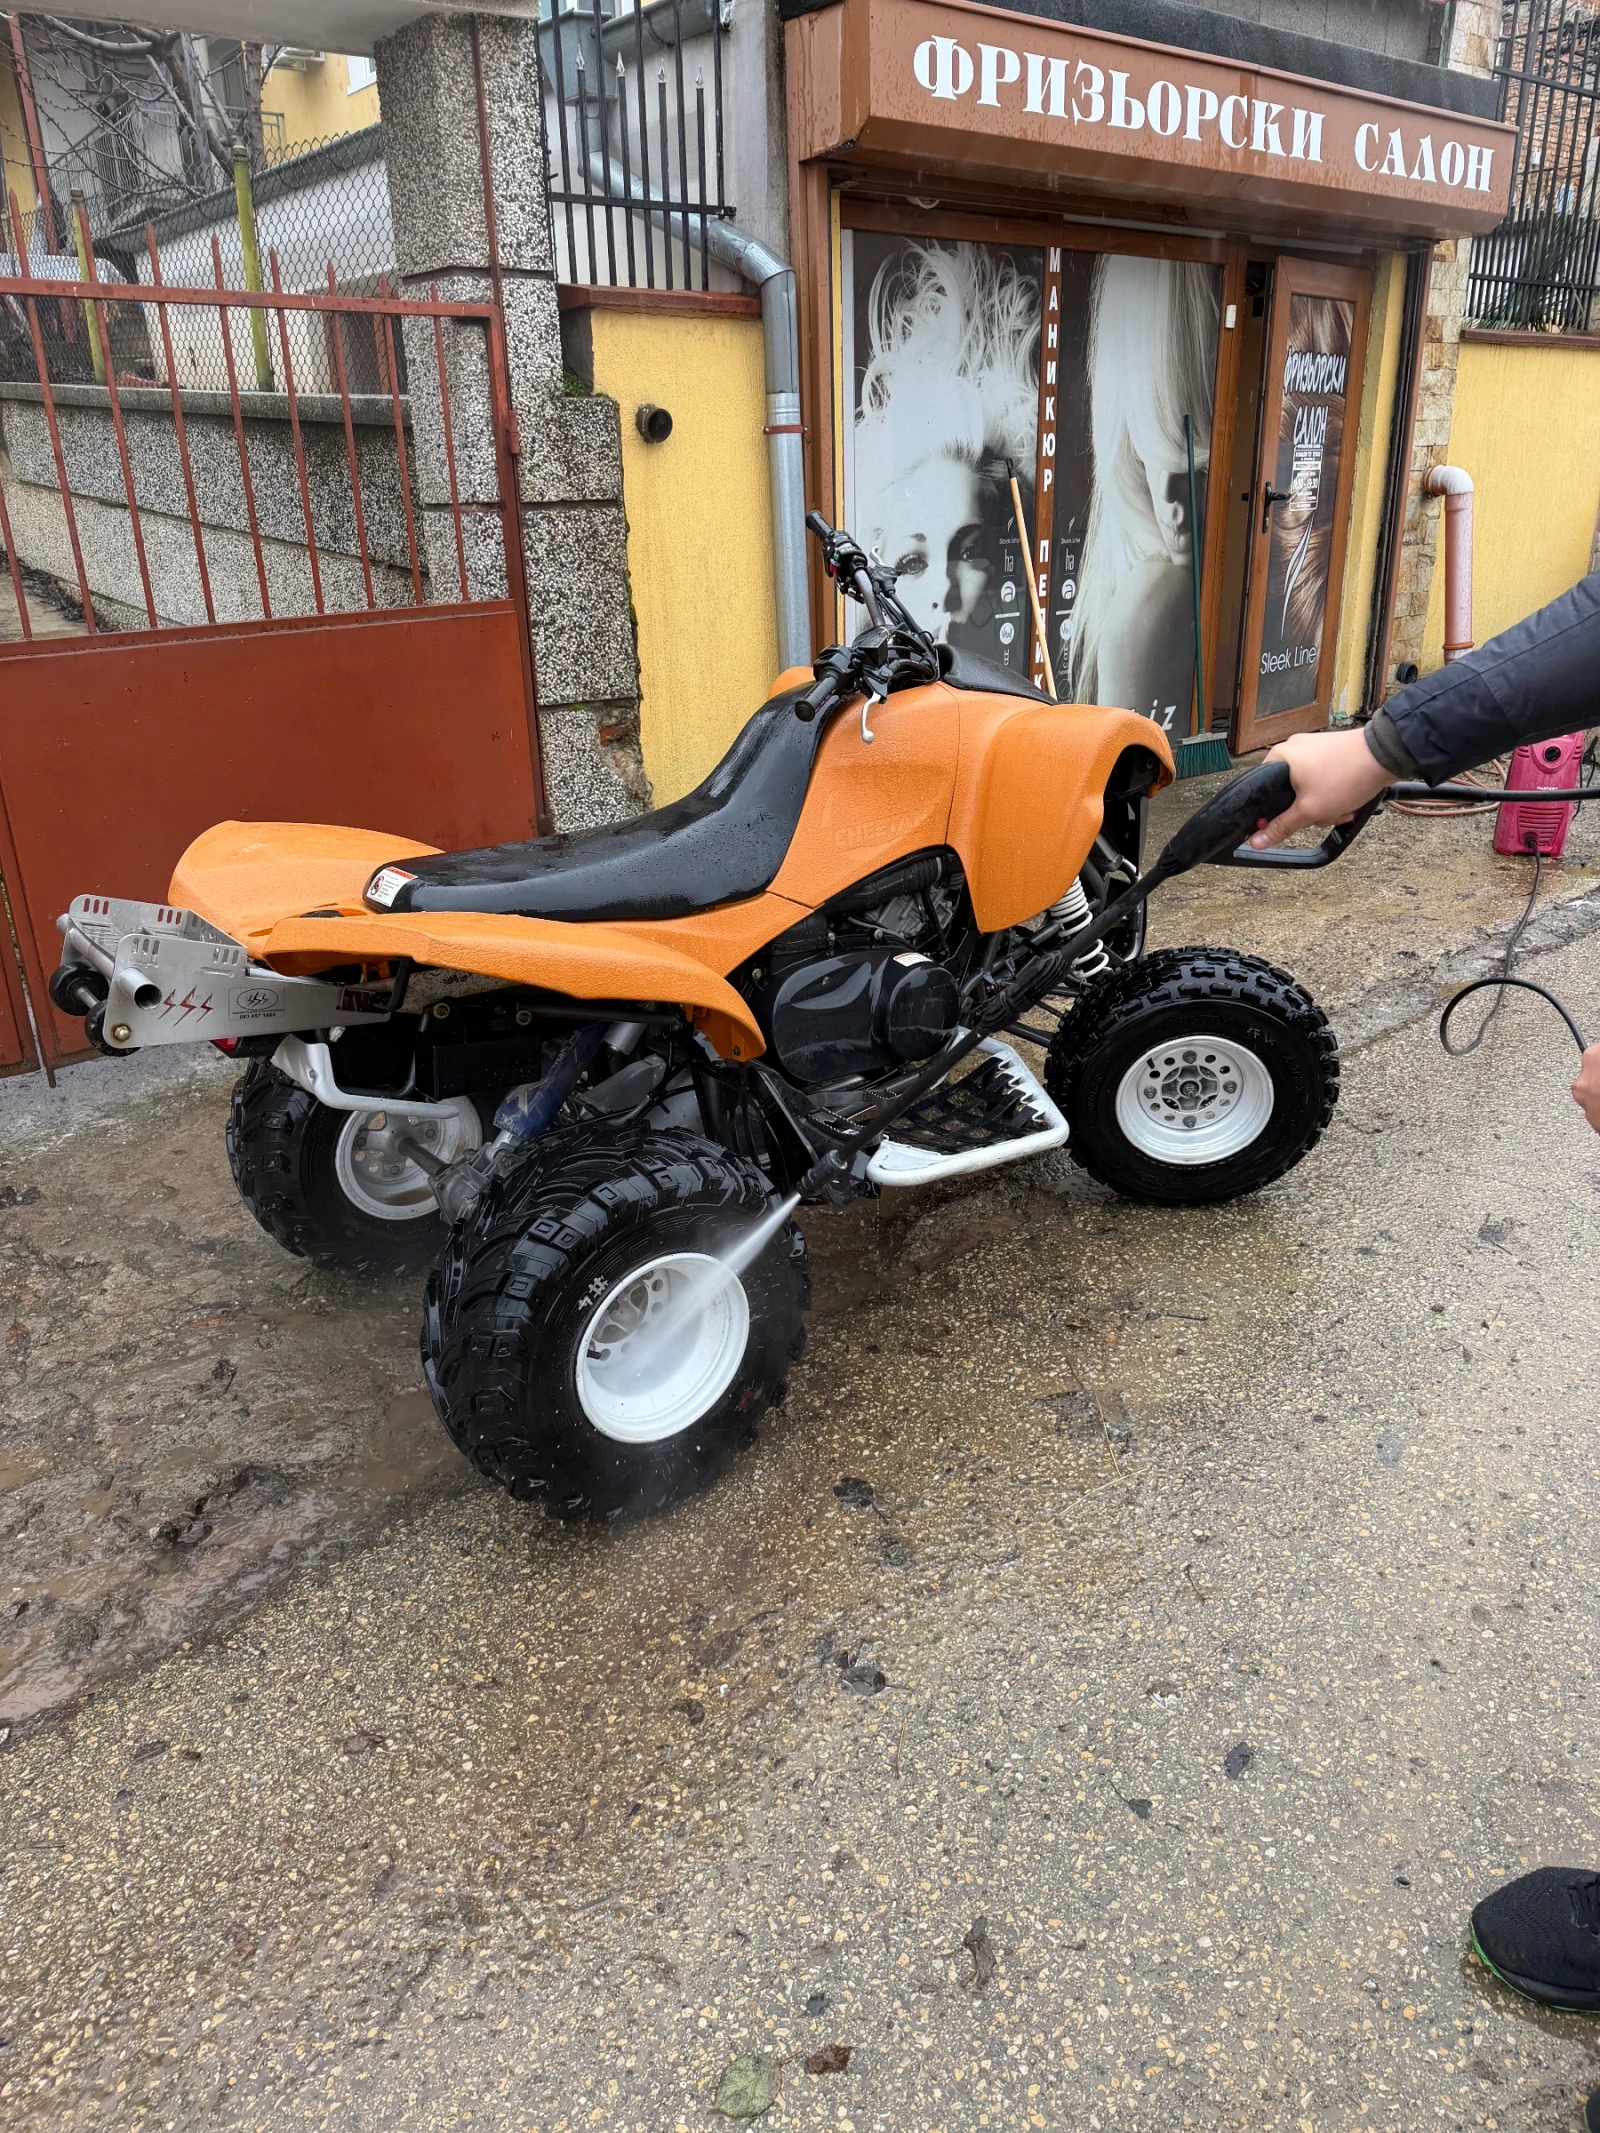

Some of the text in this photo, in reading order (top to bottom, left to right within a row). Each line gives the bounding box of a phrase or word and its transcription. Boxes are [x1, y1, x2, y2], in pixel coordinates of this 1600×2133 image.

[913, 34, 1495, 193] ФРИЗЬОРСКИ САЛОН
[1042, 246, 1061, 493] МАНИКЮР
[1284, 346, 1347, 395] ФРИЗЬОРСКИ
[1293, 405, 1329, 445] САЛОН
[1260, 645, 1317, 675] Sleek Line
